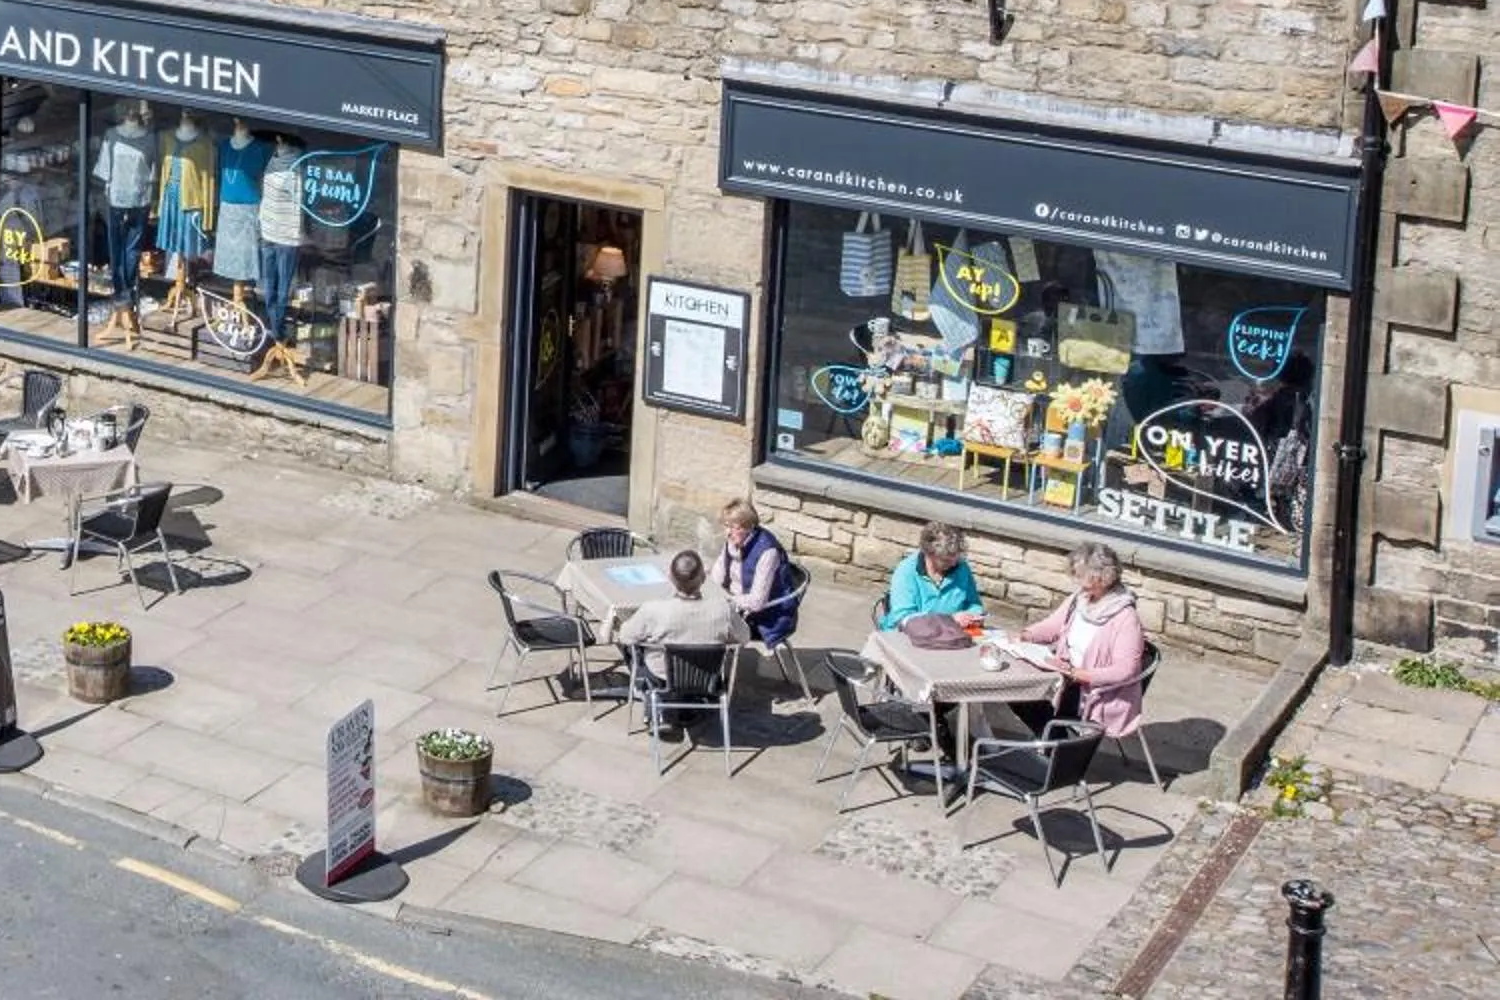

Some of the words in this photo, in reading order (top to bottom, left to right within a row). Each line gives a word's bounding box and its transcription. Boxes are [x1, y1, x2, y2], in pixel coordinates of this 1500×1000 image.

[0, 25, 82, 67] AND
[92, 37, 261, 99] KITCHEN
[341, 102, 385, 119] MARKET
[387, 109, 420, 125] PLACE
[743, 159, 964, 205] www.carandkitchen.co.uk
[4, 229, 27, 247] BY
[956, 266, 985, 282] AY
[664, 291, 730, 318] KITCHEN
[1146, 425, 1193, 449] ON
[1204, 435, 1259, 465] YER
[1200, 449, 1260, 489] bike!
[1098, 487, 1256, 553] SETTLE
